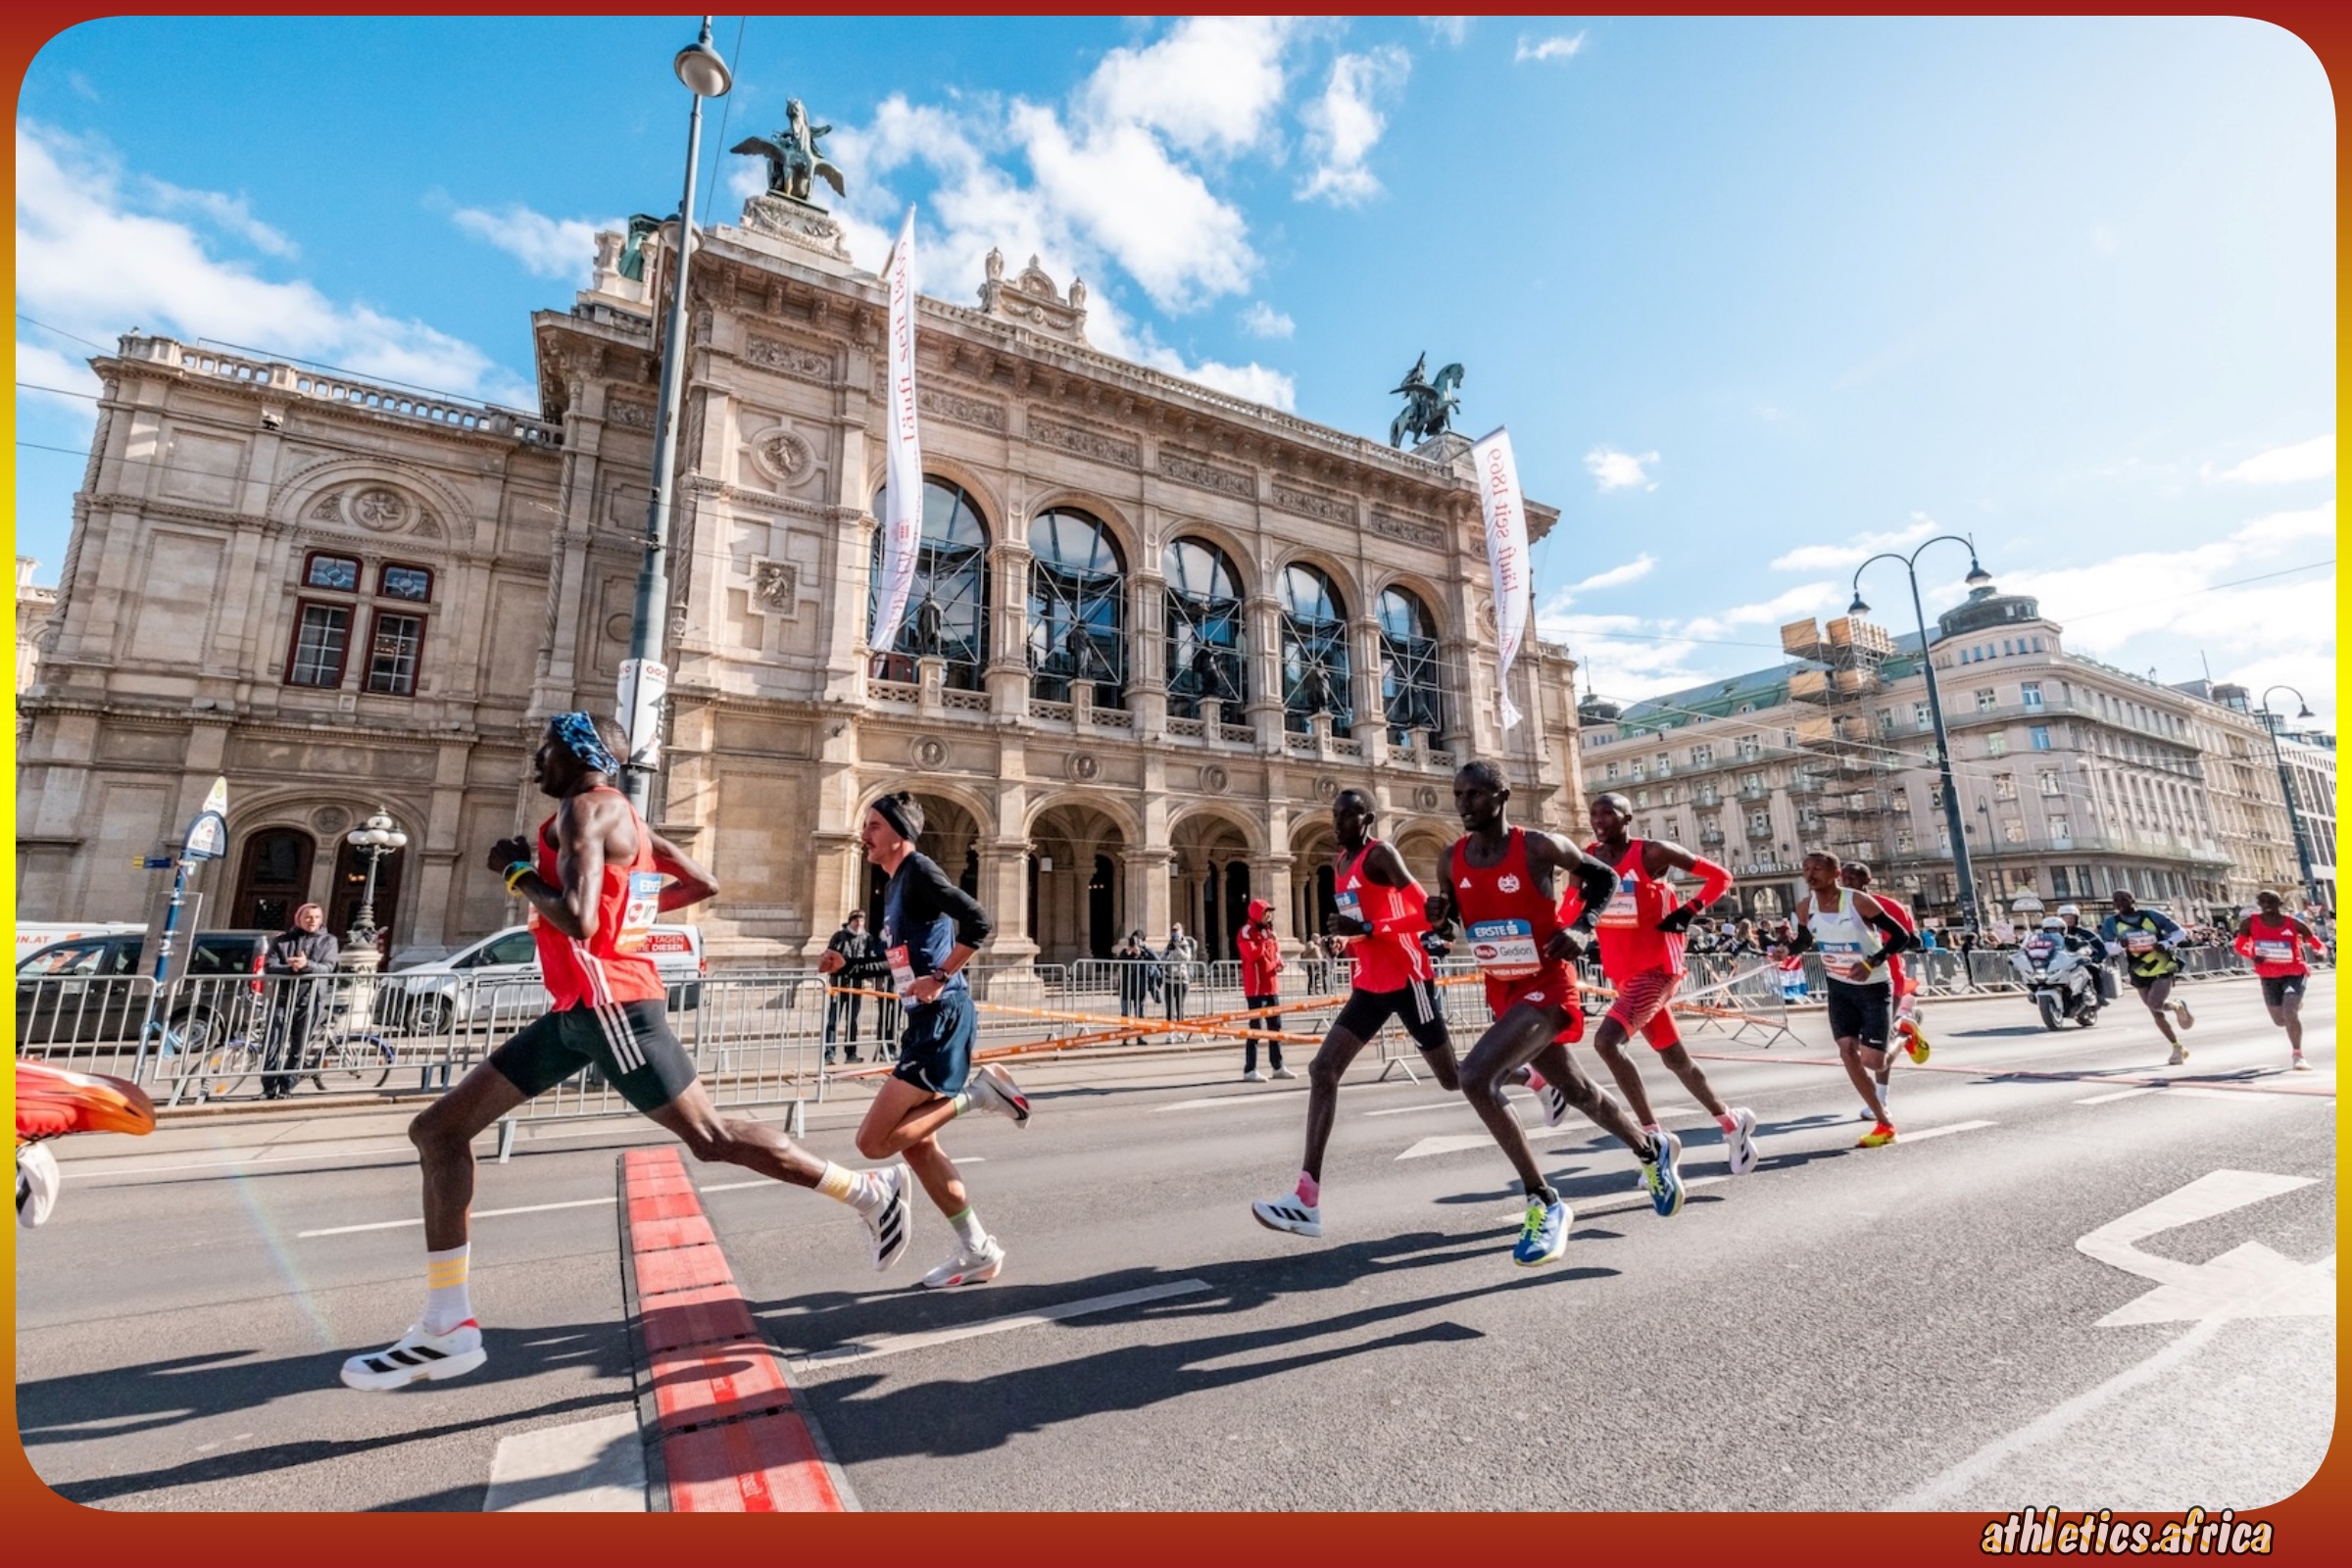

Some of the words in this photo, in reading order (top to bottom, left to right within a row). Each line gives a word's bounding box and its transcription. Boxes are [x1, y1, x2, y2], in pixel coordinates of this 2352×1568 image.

[1474, 925, 1507, 937] ERSTE
[652, 943, 684, 952] DIESEN
[1499, 946, 1533, 956] Gedion
